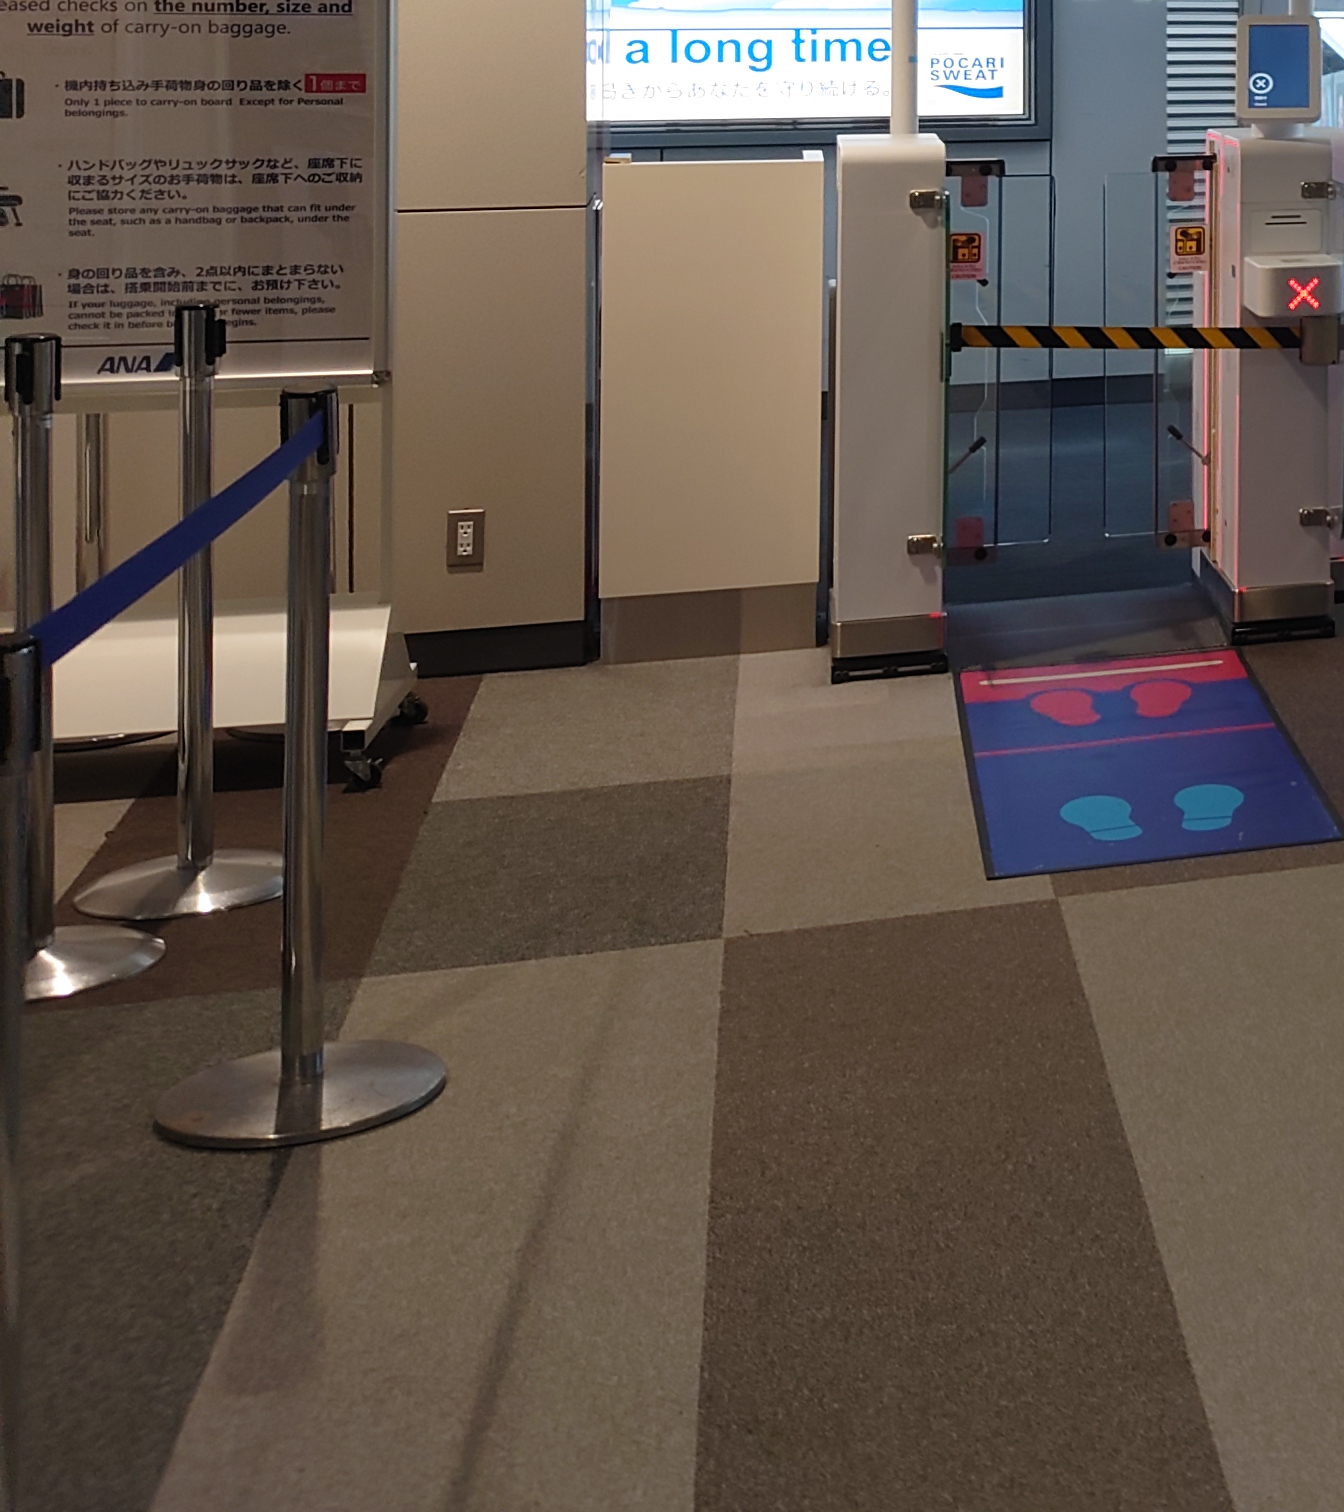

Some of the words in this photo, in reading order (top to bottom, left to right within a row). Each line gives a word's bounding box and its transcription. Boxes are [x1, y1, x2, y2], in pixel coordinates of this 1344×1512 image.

[124, 1, 148, 13] on
[276, 0, 312, 14] size
[318, 0, 353, 14] and
[27, 19, 95, 37] weight
[101, 19, 119, 33] of
[125, 21, 201, 37] carry-on
[209, 19, 290, 38] baggage.
[625, 39, 649, 64] a
[670, 29, 772, 72] long
[931, 57, 1004, 69] POCARI
[931, 69, 998, 81] SWEAT
[65, 97, 90, 108] Only
[94, 98, 99, 106] 1
[104, 97, 132, 108] piece
[136, 98, 147, 106] to
[151, 98, 197, 108] carry-on
[201, 97, 232, 106] board
[239, 97, 275, 108] Except
[279, 97, 294, 106] for
[298, 97, 344, 106] Personal
[65, 108, 128, 119] belongings.
[68, 189, 188, 201] にご協力ください。
[68, 206, 104, 216] Please
[107, 207, 136, 215] store
[139, 208, 159, 217] any
[162, 207, 209, 217] carry-on
[212, 205, 259, 215] baggage
[262, 204, 284, 213] that
[287, 205, 307, 213] can
[309, 204, 321, 212] fit
[324, 204, 356, 213] under
[68, 217, 86, 226] the
[90, 217, 116, 227] seat,
[120, 217, 146, 226] such
[149, 218, 161, 226] as
[174, 216, 222, 226] handbag
[240, 215, 294, 225] backpack,
[297, 215, 329, 223] under
[332, 214, 350, 223] the
[68, 229, 95, 237] seat.
[68, 300, 79, 309] If
[81, 301, 106, 310] your
[110, 299, 156, 310] luggage,
[263, 296, 325, 306] belongings,
[68, 311, 105, 320] cannot
[109, 311, 123, 319] be
[126, 310, 165, 320] packed
[231, 307, 262, 315] fewer
[265, 306, 298, 316] items,
[301, 306, 336, 316] please
[68, 322, 100, 330] check
[114, 321, 124, 329] in
[127, 320, 164, 329] before
[225, 319, 257, 328] egins.
[97, 356, 152, 374] ANA
